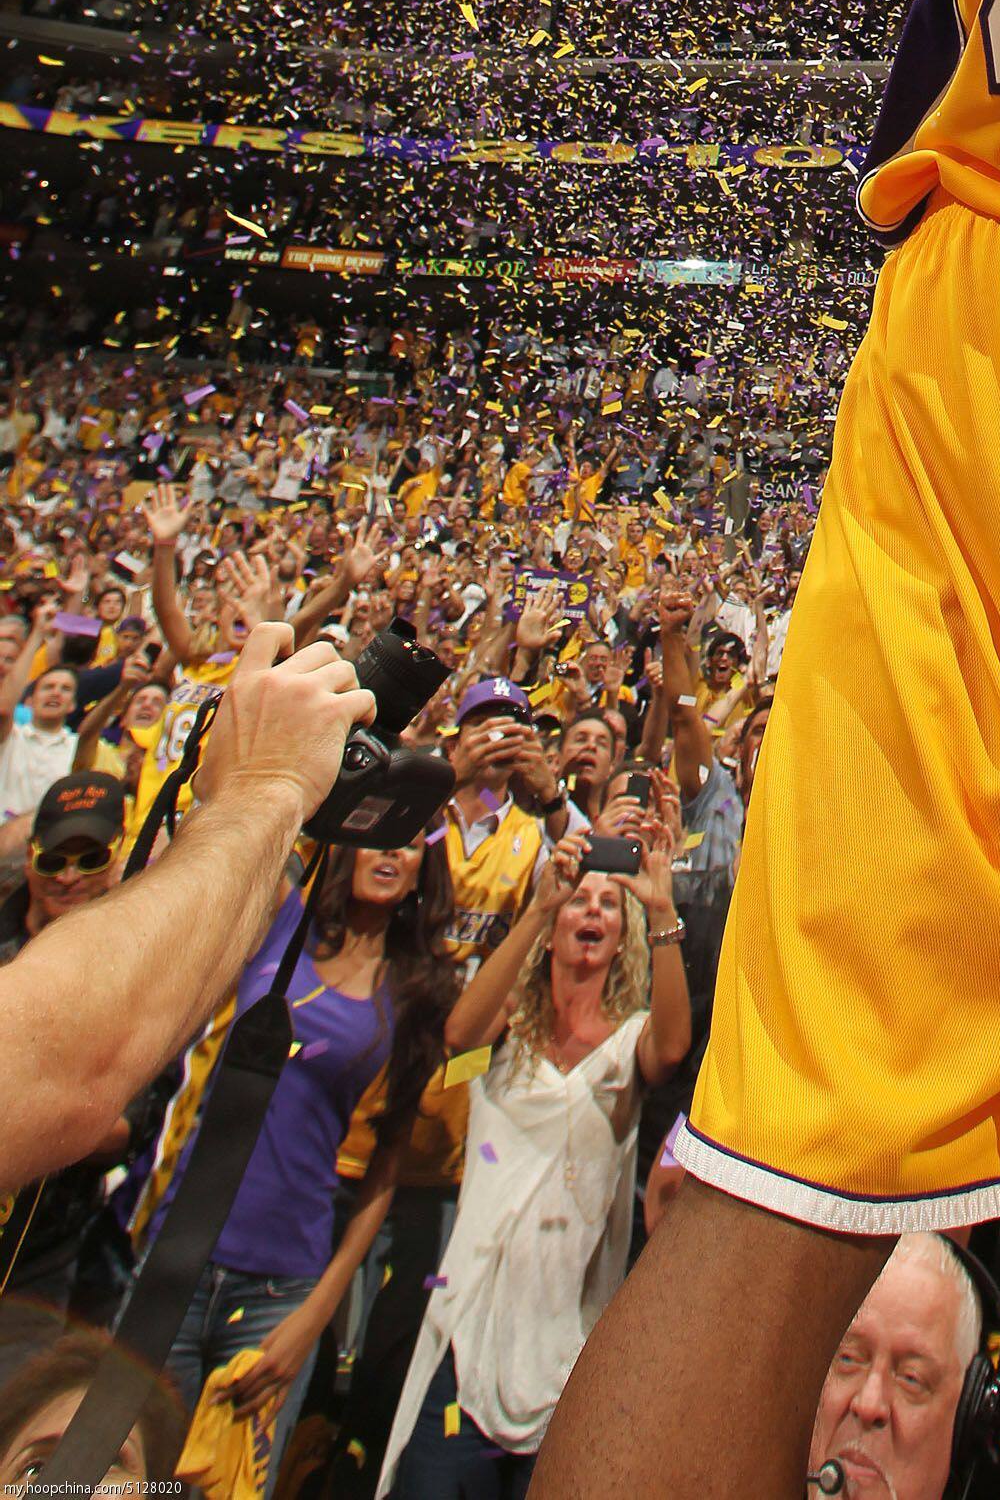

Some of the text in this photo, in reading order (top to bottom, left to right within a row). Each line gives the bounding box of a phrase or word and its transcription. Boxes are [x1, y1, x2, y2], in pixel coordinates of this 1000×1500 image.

[448, 140, 845, 168] 2010
[224, 248, 280, 263] verion
[762, 482, 799, 499] SAN
